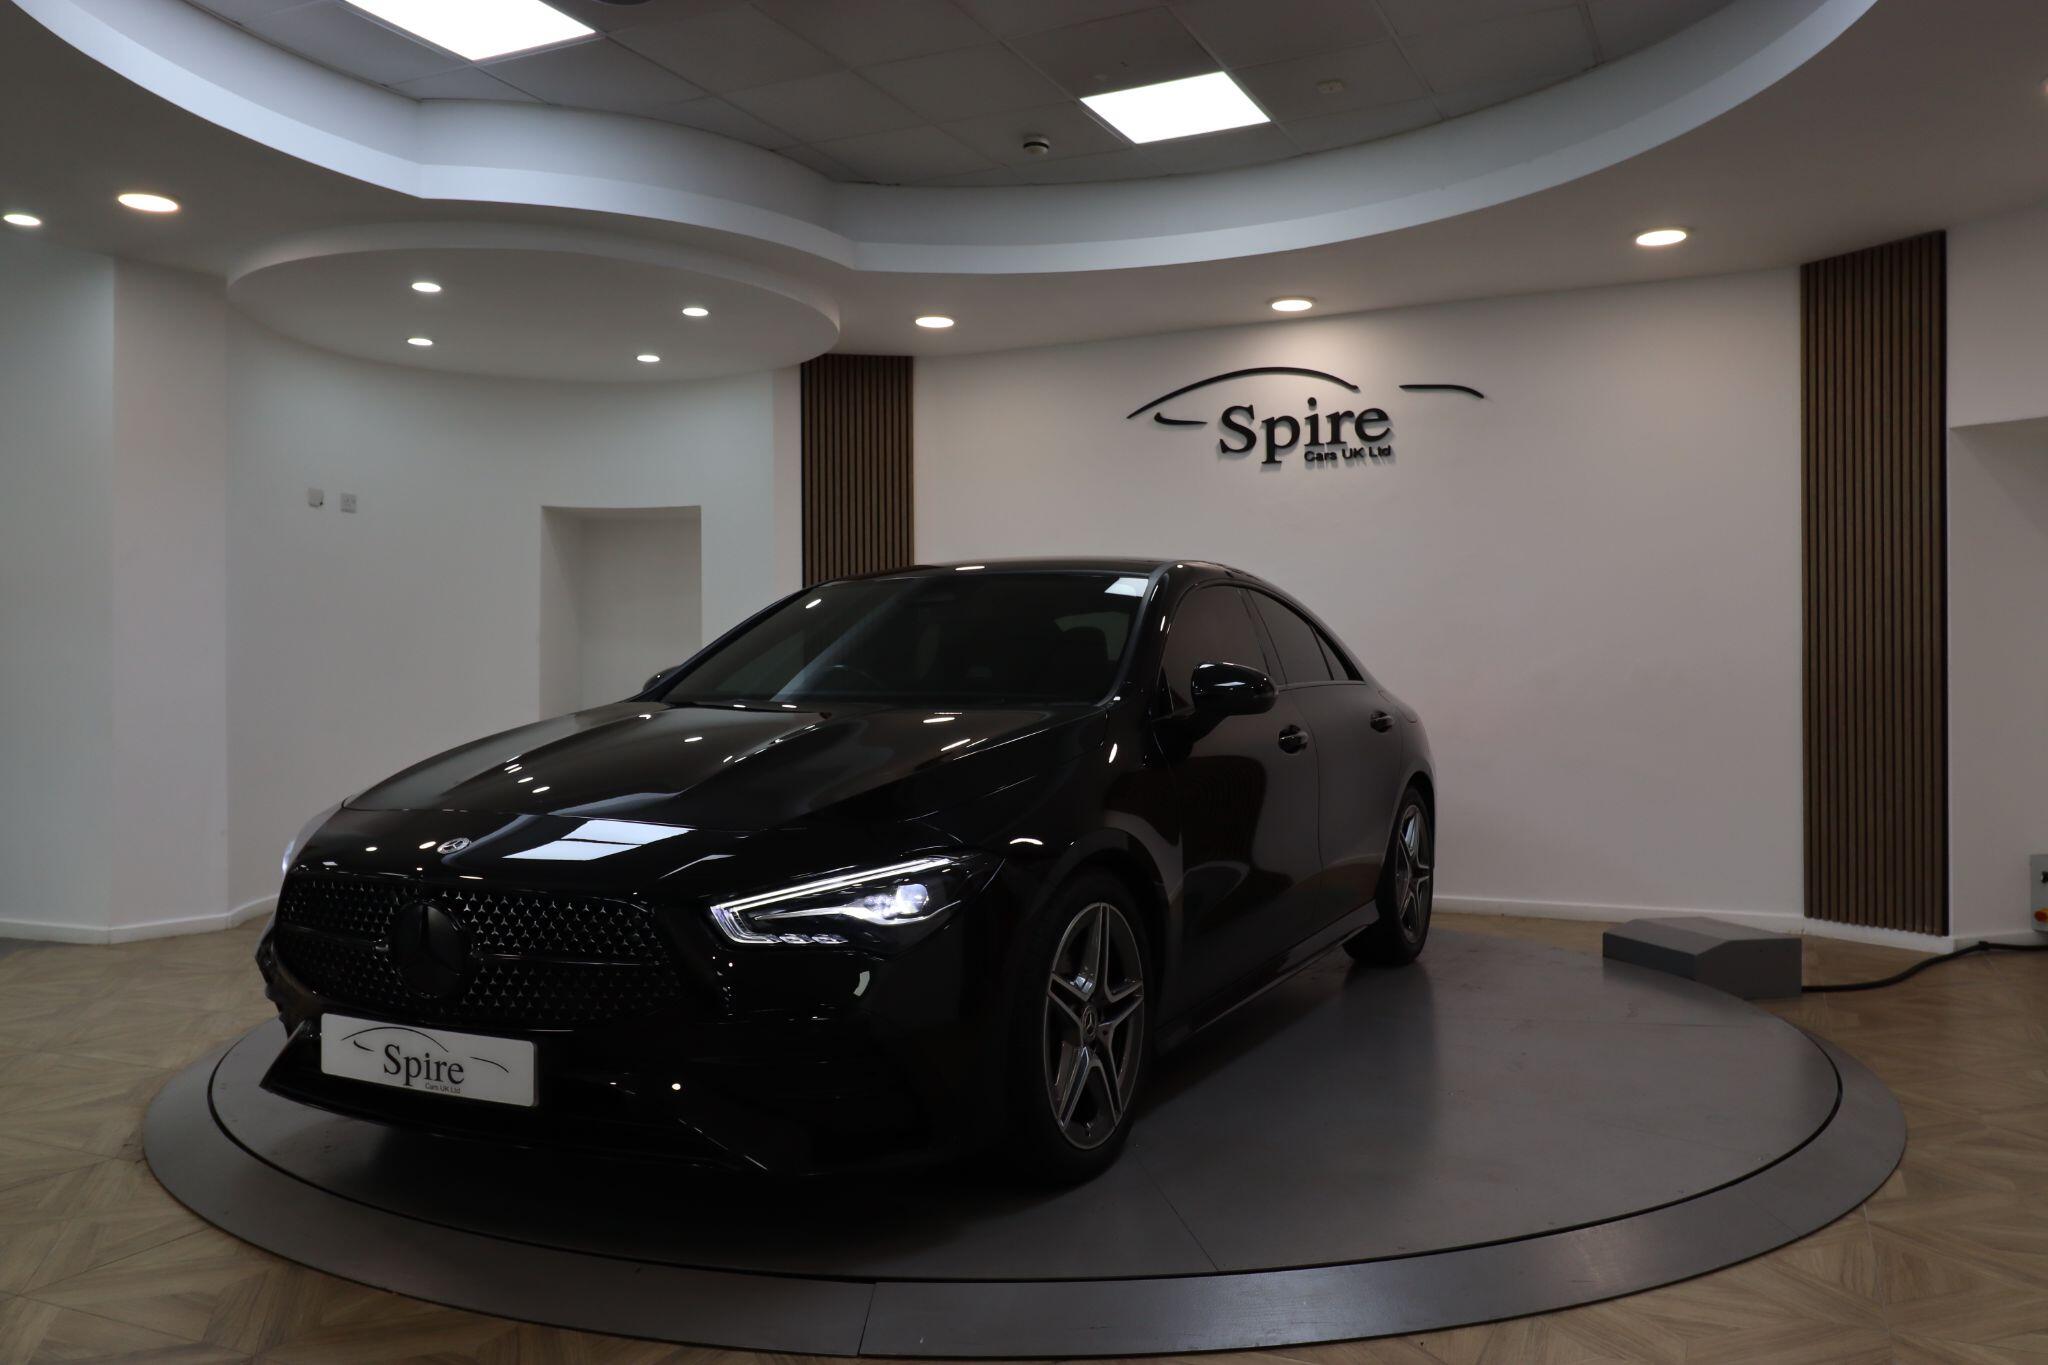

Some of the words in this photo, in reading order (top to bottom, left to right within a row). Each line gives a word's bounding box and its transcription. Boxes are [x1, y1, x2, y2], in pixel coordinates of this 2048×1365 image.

[1219, 397, 1391, 464] Spire
[1304, 450, 1337, 462] Cars
[1341, 447, 1364, 459] UK
[1368, 445, 1391, 458] Ltd
[384, 1044, 464, 1086] Spire
[439, 1085, 449, 1093] UK
